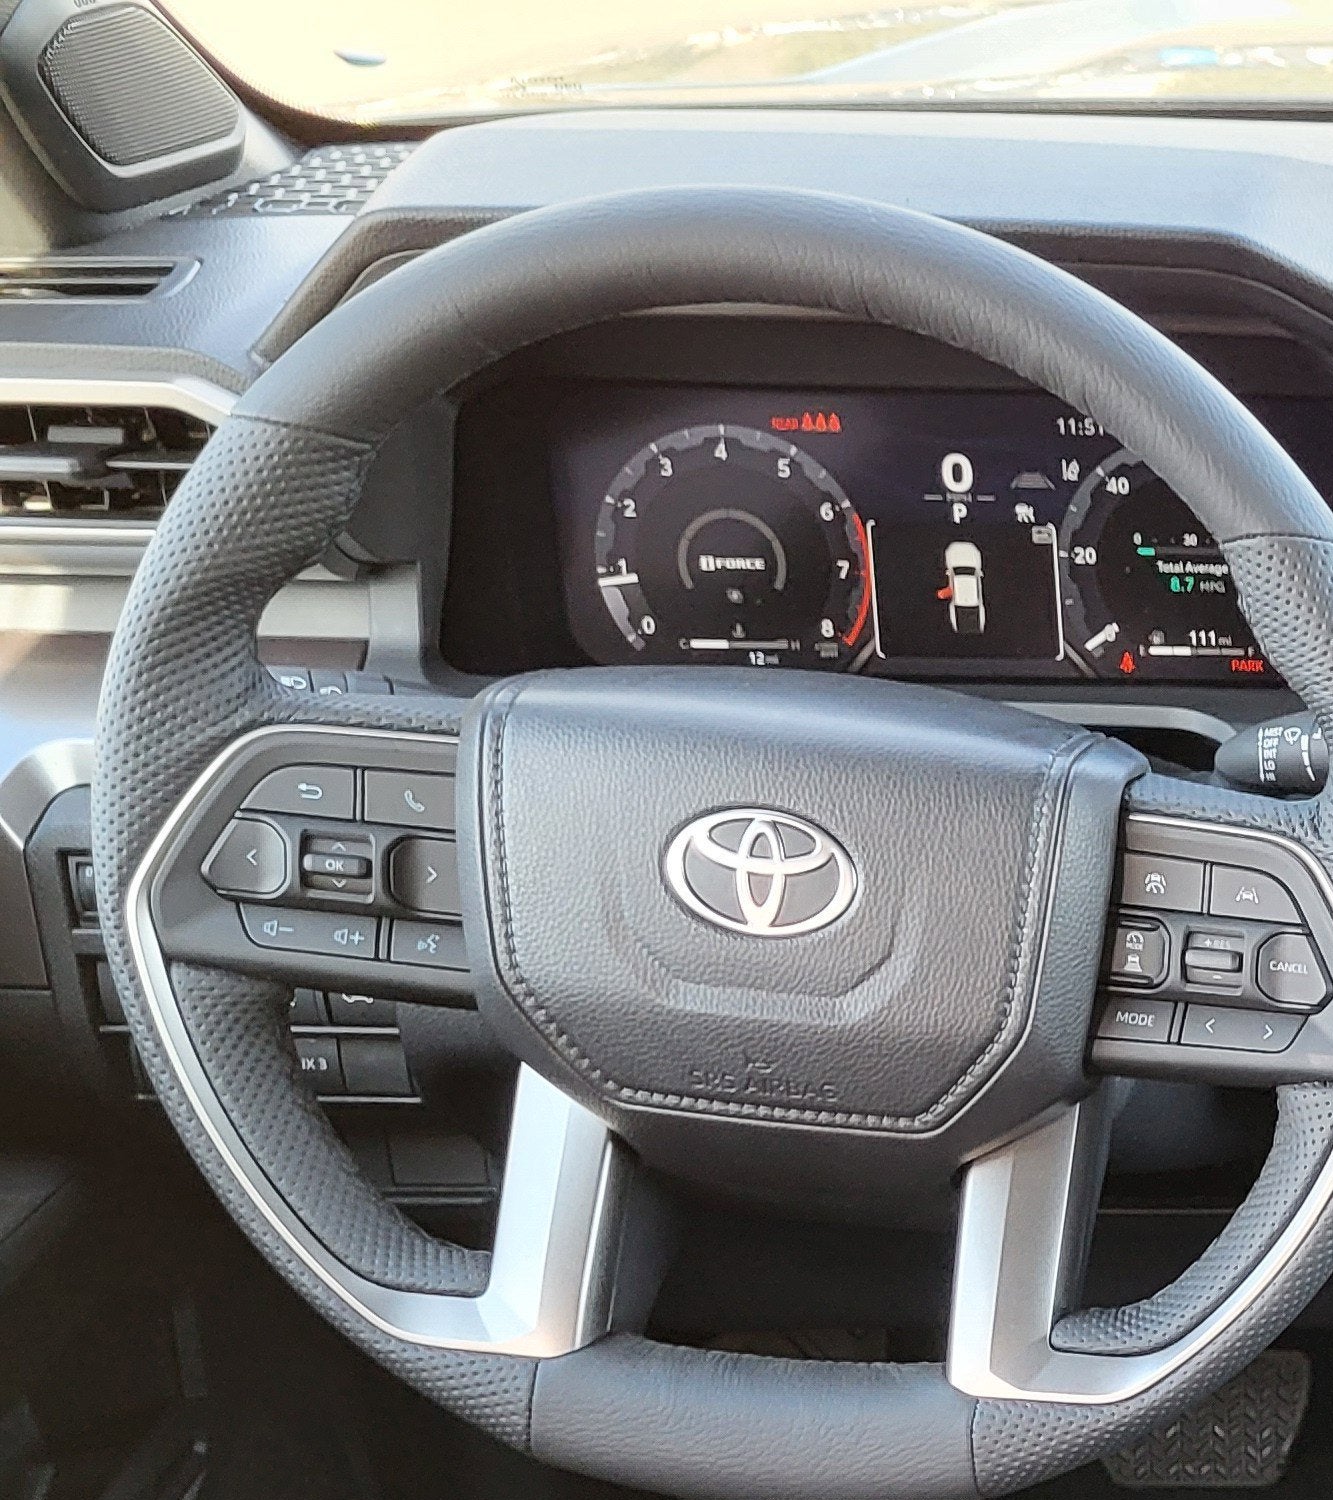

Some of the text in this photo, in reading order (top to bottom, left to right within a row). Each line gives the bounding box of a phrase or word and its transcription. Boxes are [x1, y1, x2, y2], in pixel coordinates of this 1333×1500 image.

[714, 440, 728, 461] 4
[660, 457, 673, 477] 3
[777, 458, 791, 478] 5
[941, 452, 974, 493] 0
[1106, 476, 1130, 495] 40
[623, 498, 637, 518] 2
[819, 502, 834, 521] 6
[952, 503, 968, 524] P
[1073, 546, 1097, 565] 20
[836, 559, 849, 580] 7
[1156, 560, 1229, 577] Total Average
[641, 615, 656, 635] 0
[821, 618, 835, 638] 8
[1189, 629, 1216, 647] 111
[749, 651, 765, 666] 12
[1231, 659, 1264, 672] PARK
[325, 860, 344, 873] OK
[1269, 960, 1308, 974] CANCEL
[1115, 1011, 1155, 1027] MODE
[318, 1057, 328, 1070] 3
